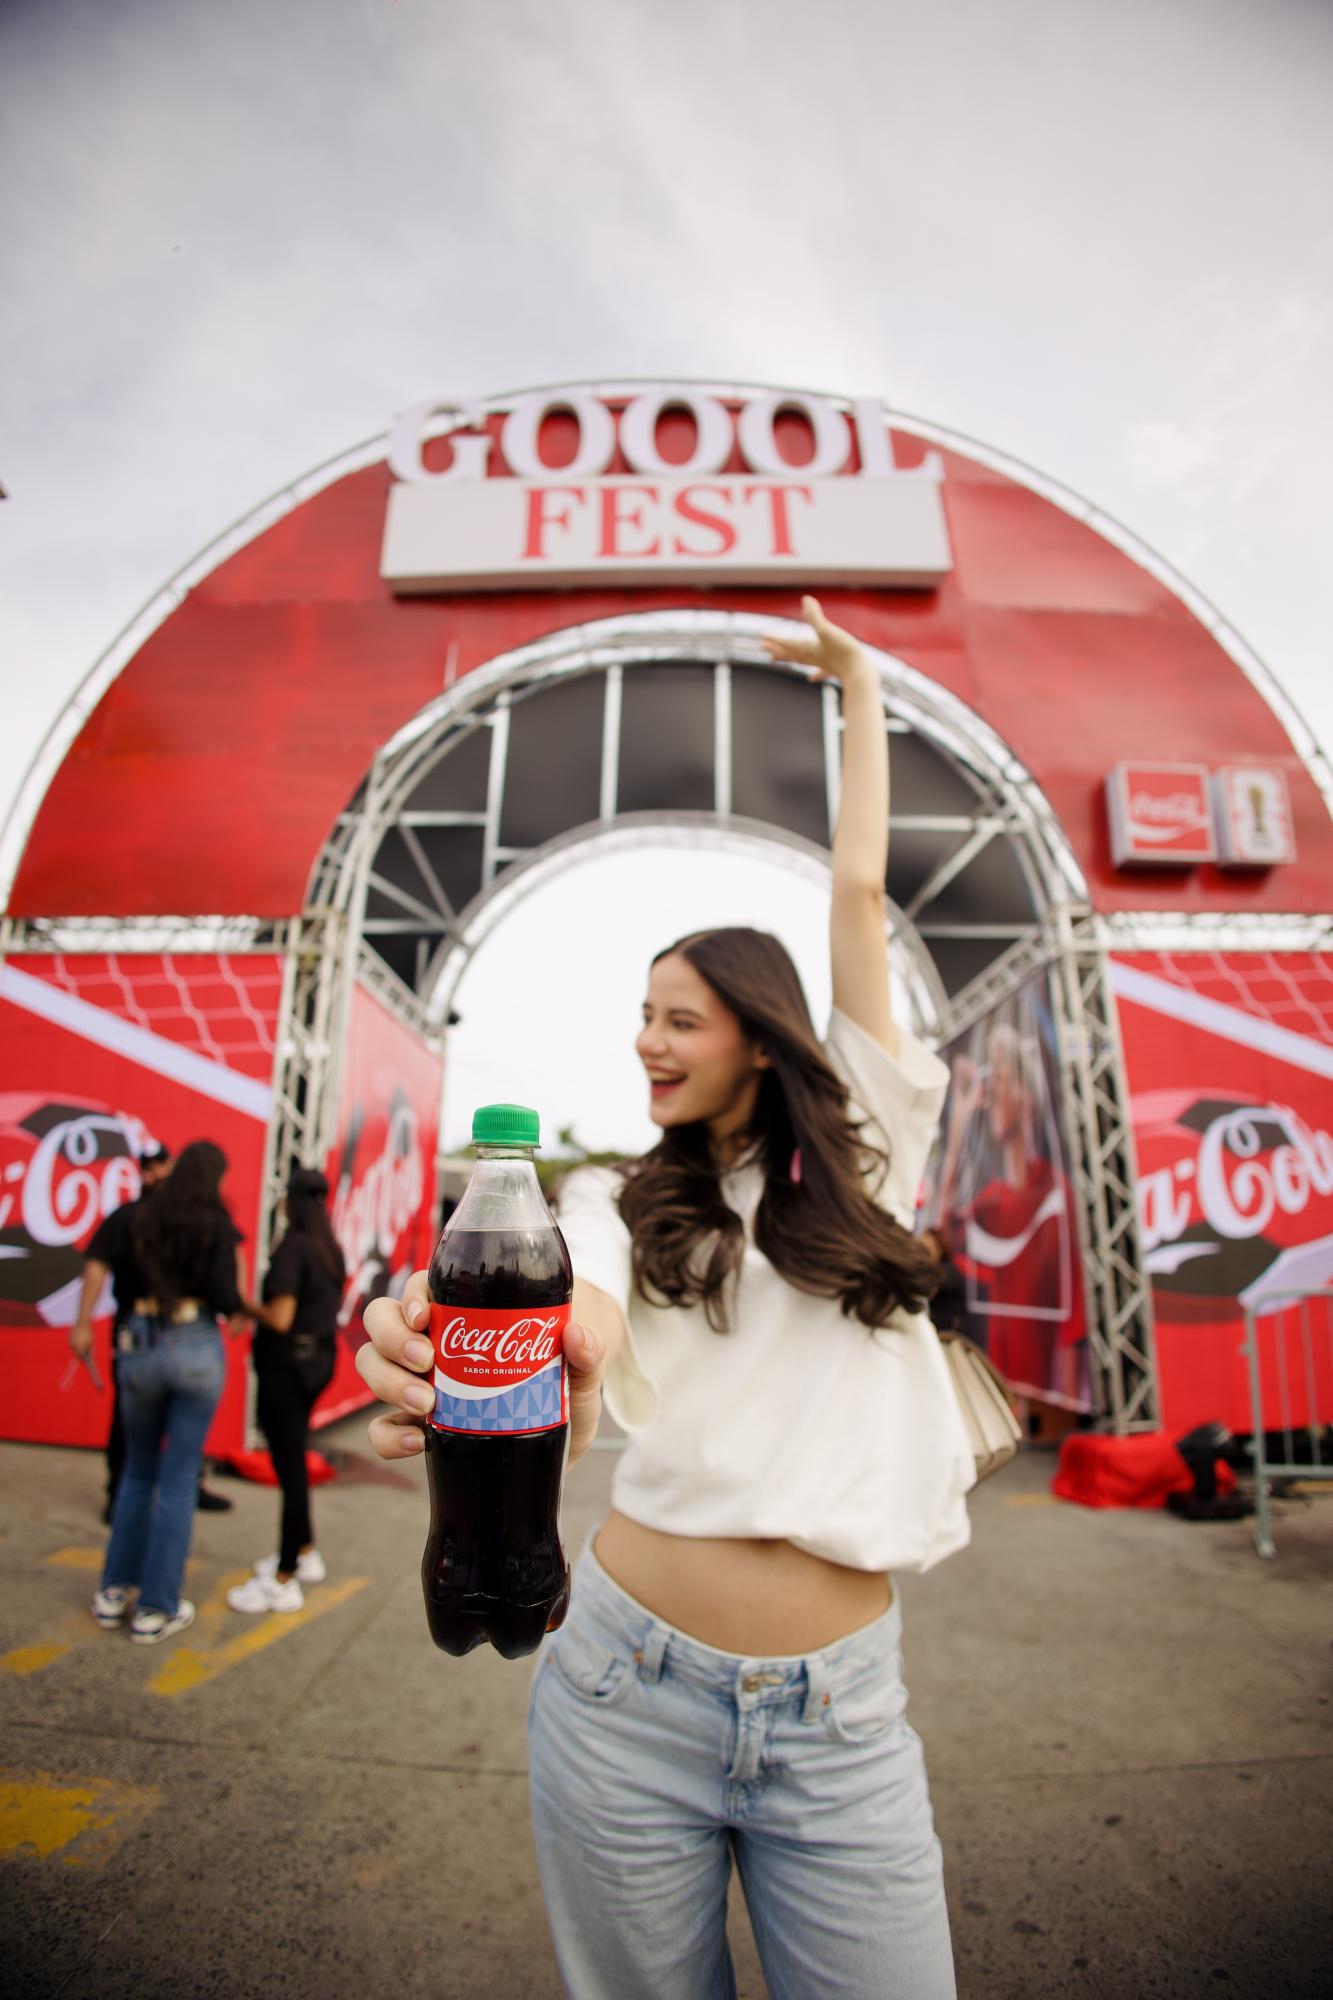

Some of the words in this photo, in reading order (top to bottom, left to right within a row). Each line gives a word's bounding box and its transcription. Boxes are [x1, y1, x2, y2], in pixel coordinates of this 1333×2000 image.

[386, 394, 945, 484] GOOOL
[517, 485, 814, 560] FEST
[441, 1317, 560, 1362] Coca-Cola
